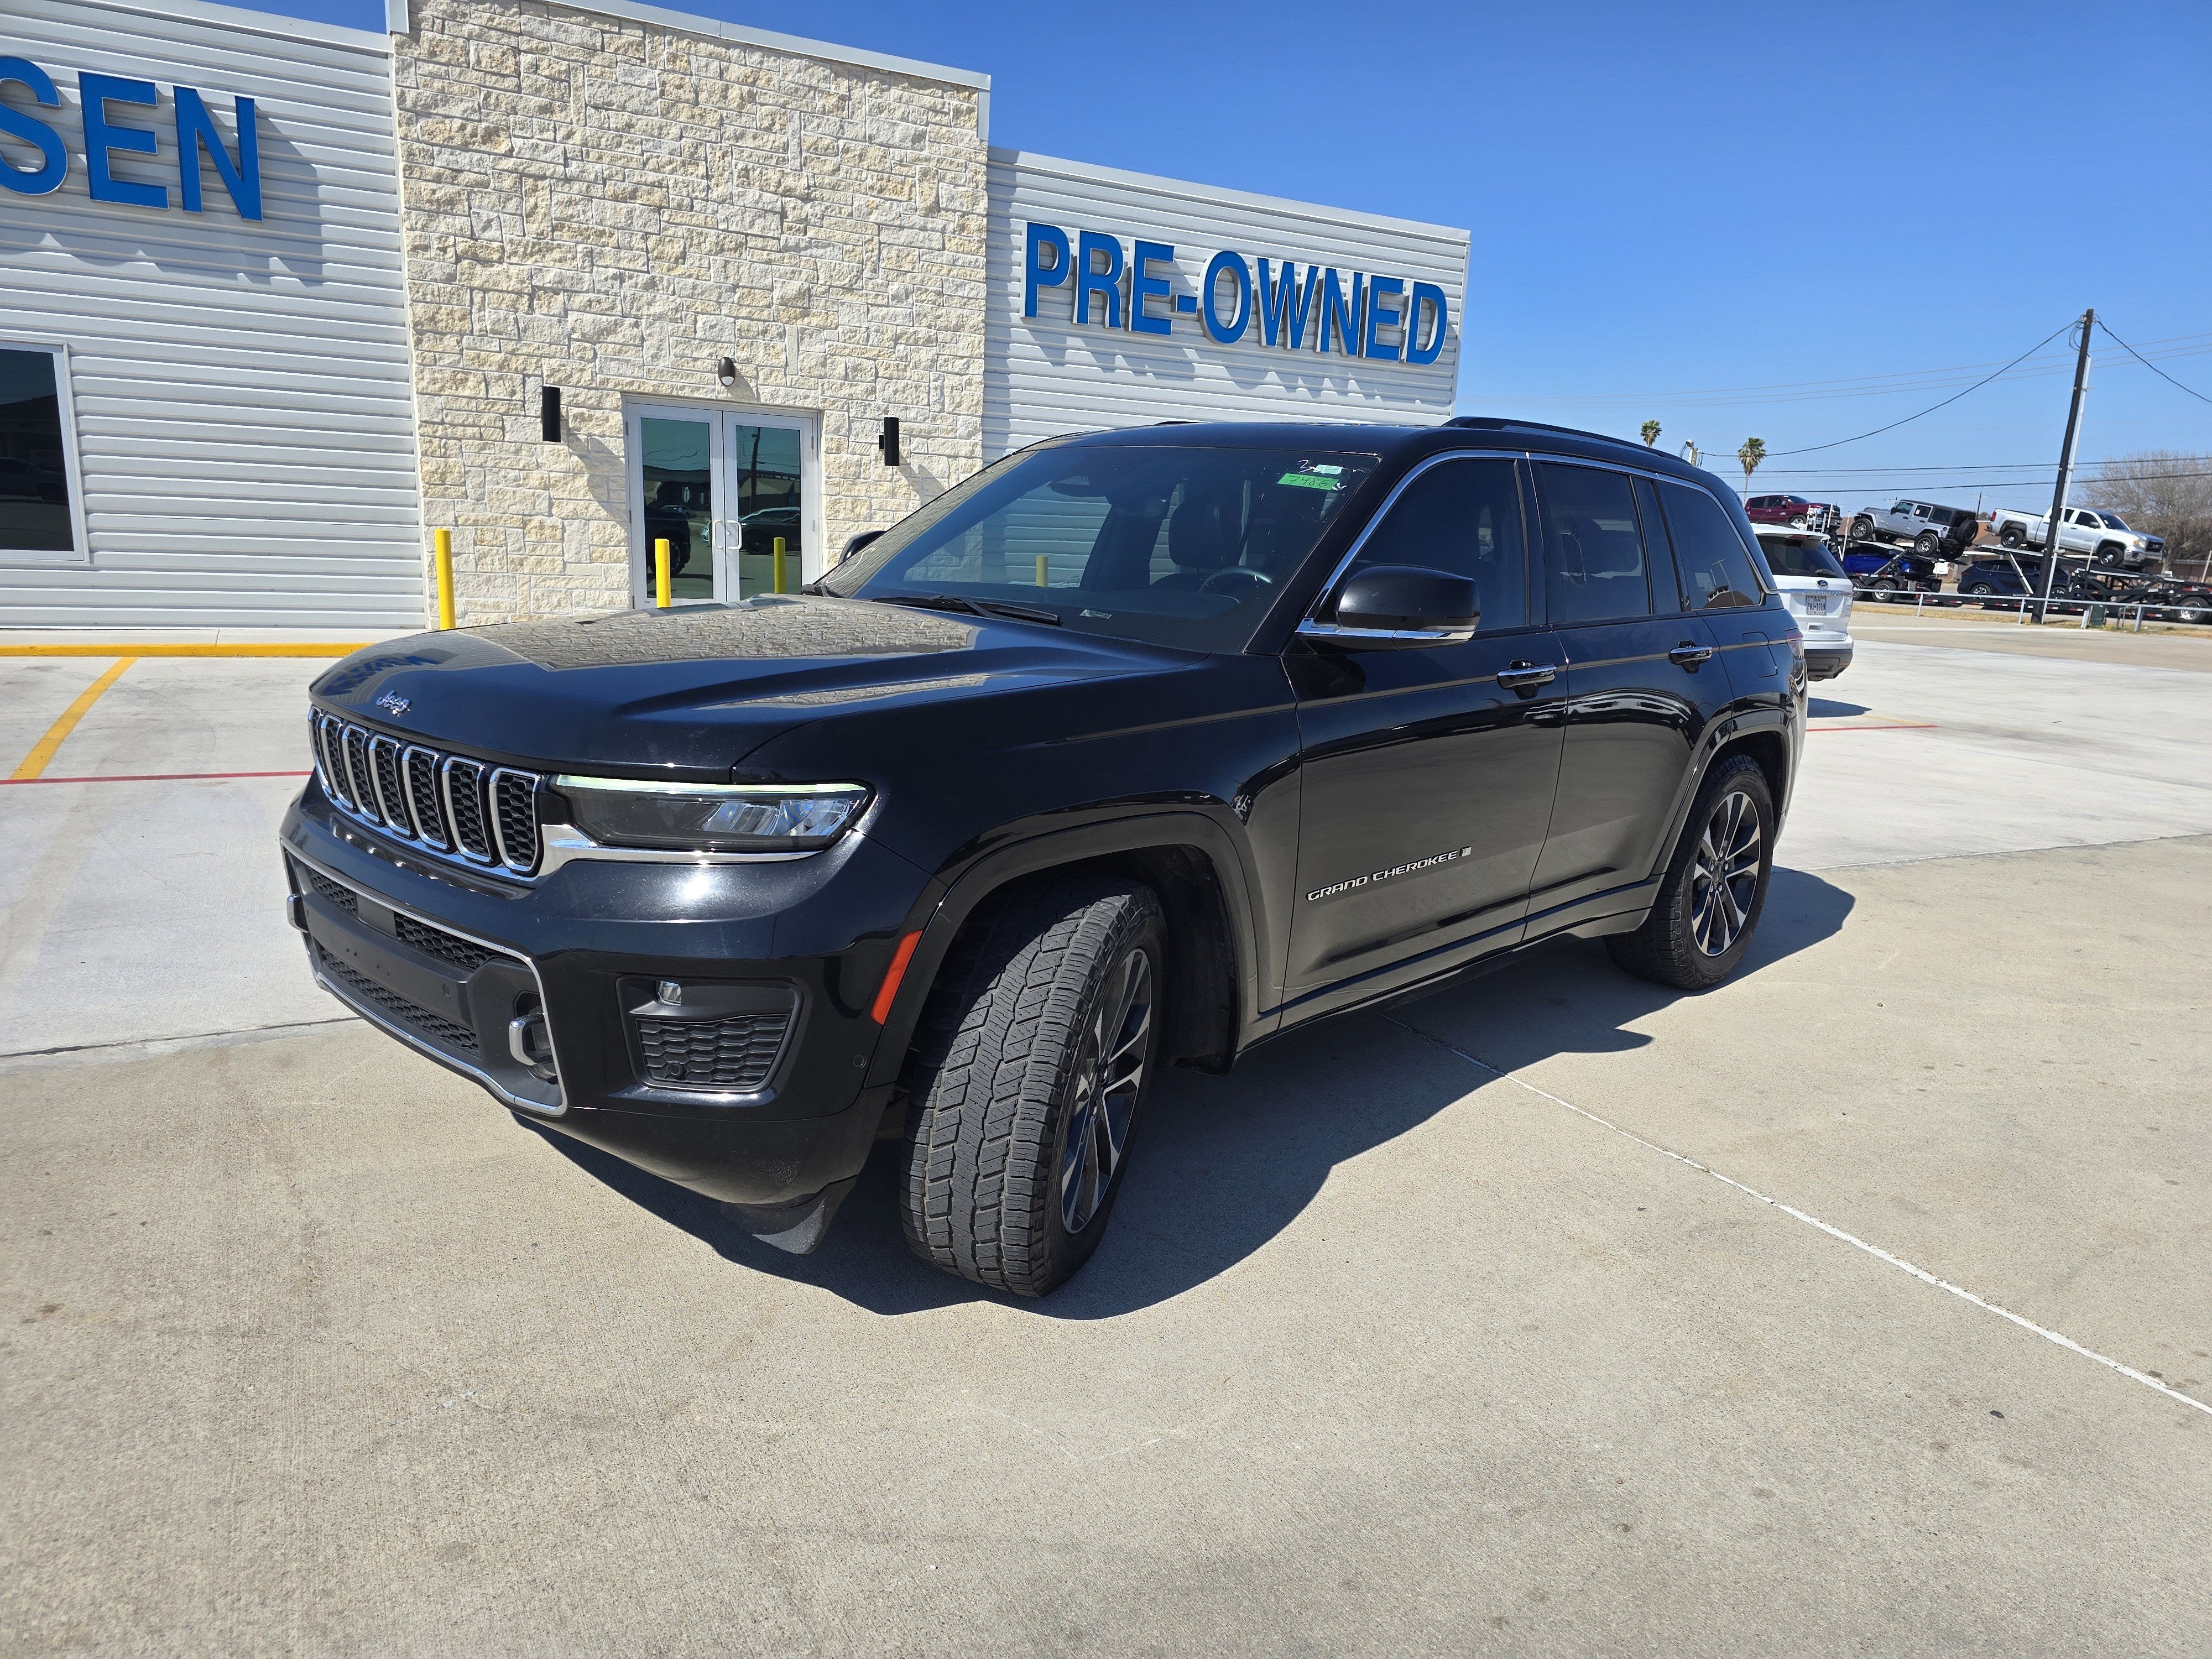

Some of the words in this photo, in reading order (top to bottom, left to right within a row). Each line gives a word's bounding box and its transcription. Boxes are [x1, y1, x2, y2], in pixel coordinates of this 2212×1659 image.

[0, 55, 263, 222] SEN
[1021, 221, 1448, 366] PRE-OWNED
[376, 690, 411, 717] Jeep
[1307, 875, 1368, 901] GRAND
[1372, 850, 1458, 881] CHEROKEE
